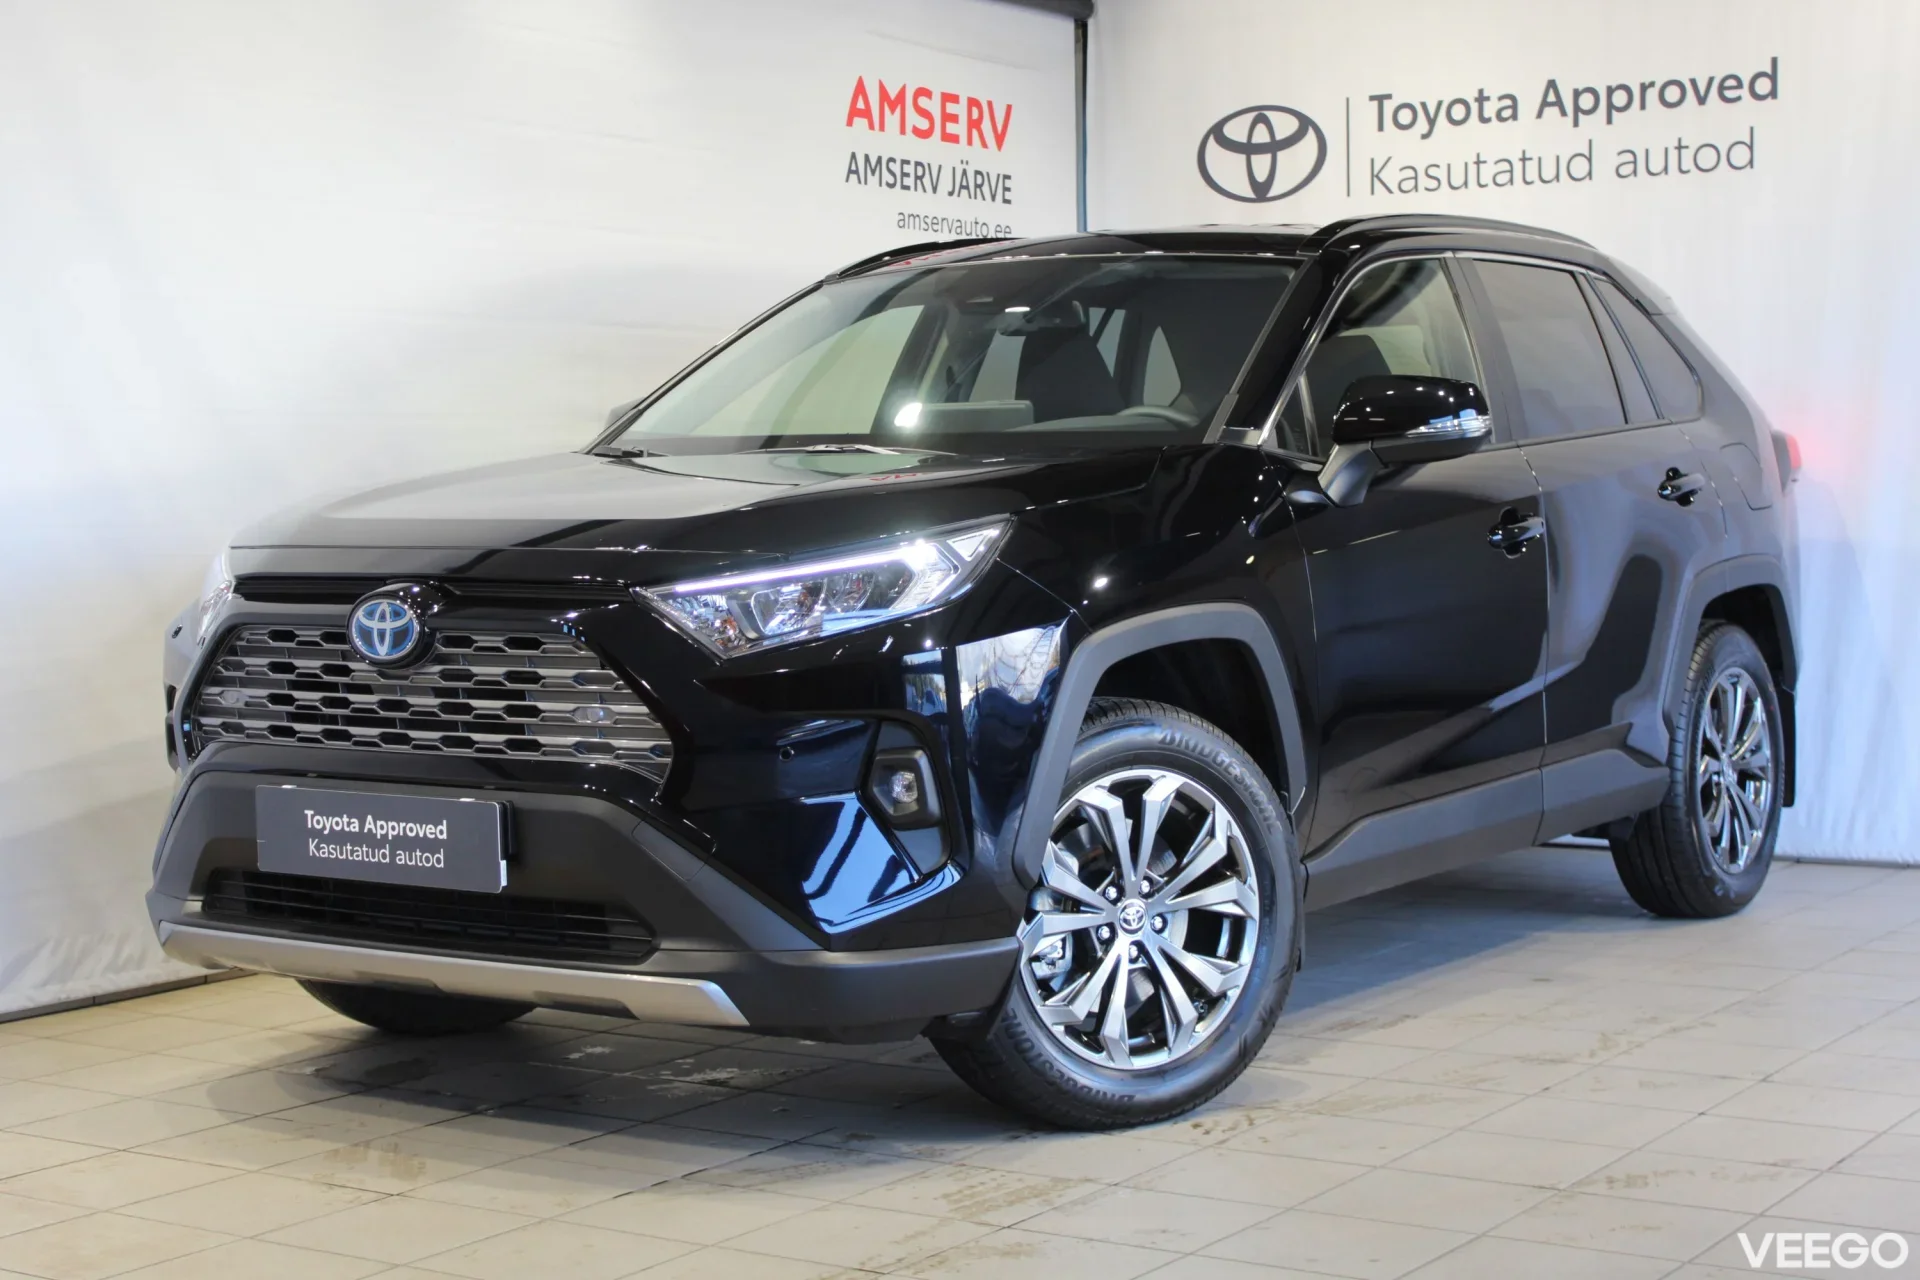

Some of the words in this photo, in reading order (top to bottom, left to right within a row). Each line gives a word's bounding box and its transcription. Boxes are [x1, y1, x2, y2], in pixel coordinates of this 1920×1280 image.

[845, 75, 1013, 152] AMSERV
[1369, 88, 1519, 139] Toyota
[1536, 56, 1780, 127] Approved
[845, 151, 942, 194] AMSERV
[947, 159, 1012, 205] JÄRVE
[1369, 139, 1594, 197] Kasutatud
[1615, 126, 1756, 180] autod
[897, 211, 1012, 239] amservauto.ee
[304, 810, 360, 835] Toyota
[364, 814, 448, 840] Approved
[309, 838, 390, 864] Kasutatud
[395, 848, 444, 868] autod
